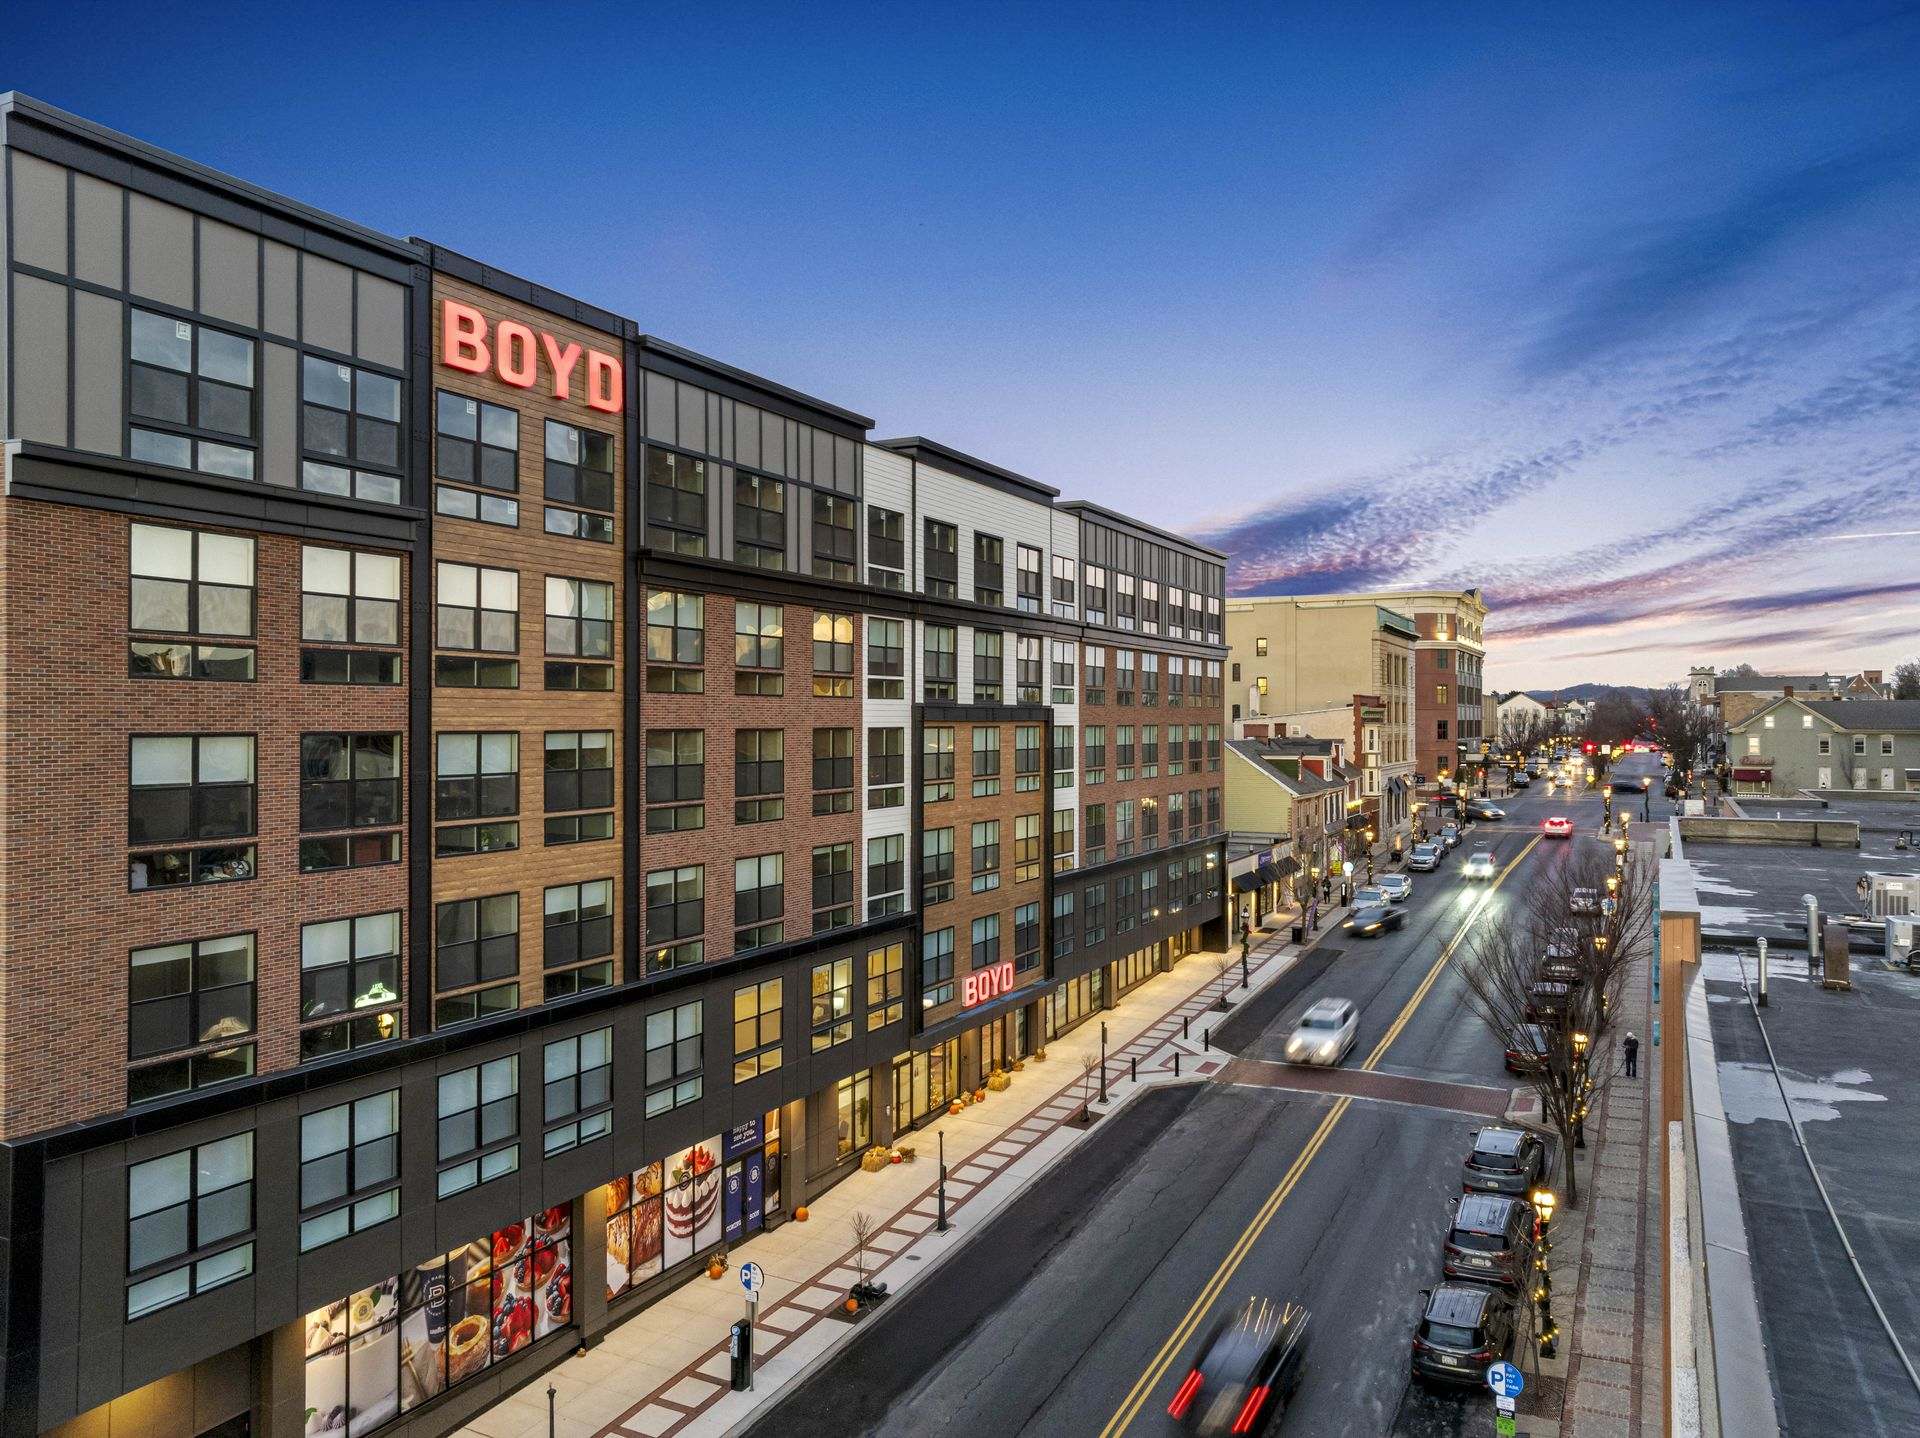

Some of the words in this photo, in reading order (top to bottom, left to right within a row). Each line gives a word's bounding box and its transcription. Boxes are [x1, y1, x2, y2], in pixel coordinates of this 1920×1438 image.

[440, 299, 624, 414] BOYD
[962, 962, 1014, 1007] BOYD
[1491, 1370, 1504, 1386] P
